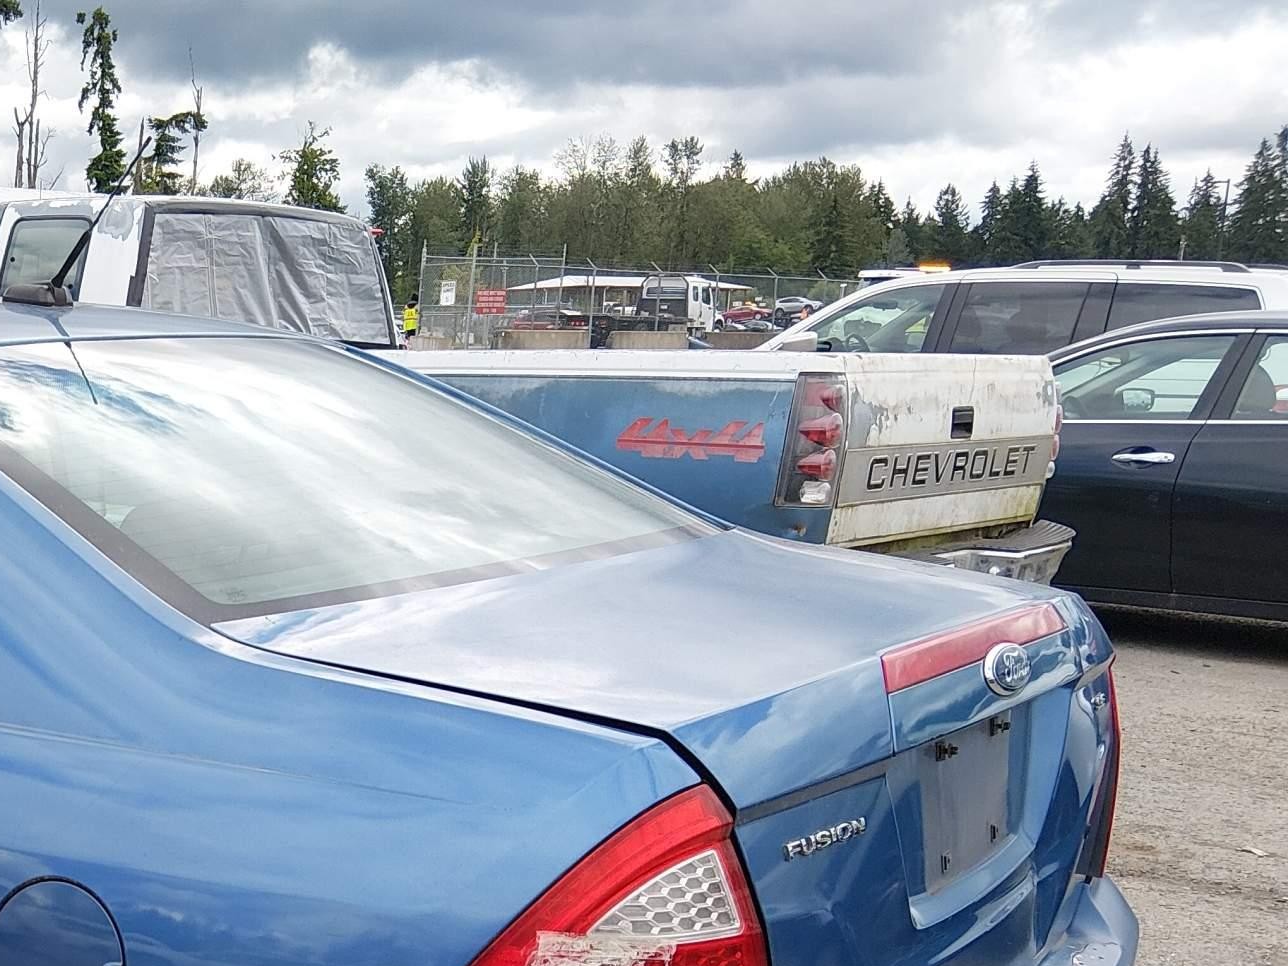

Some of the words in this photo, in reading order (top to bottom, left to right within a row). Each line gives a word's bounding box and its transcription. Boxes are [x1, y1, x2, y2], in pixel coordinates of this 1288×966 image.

[616, 416, 765, 464] 4x4
[866, 445, 1037, 491] CHEVROLET
[783, 816, 867, 861] FUSION
